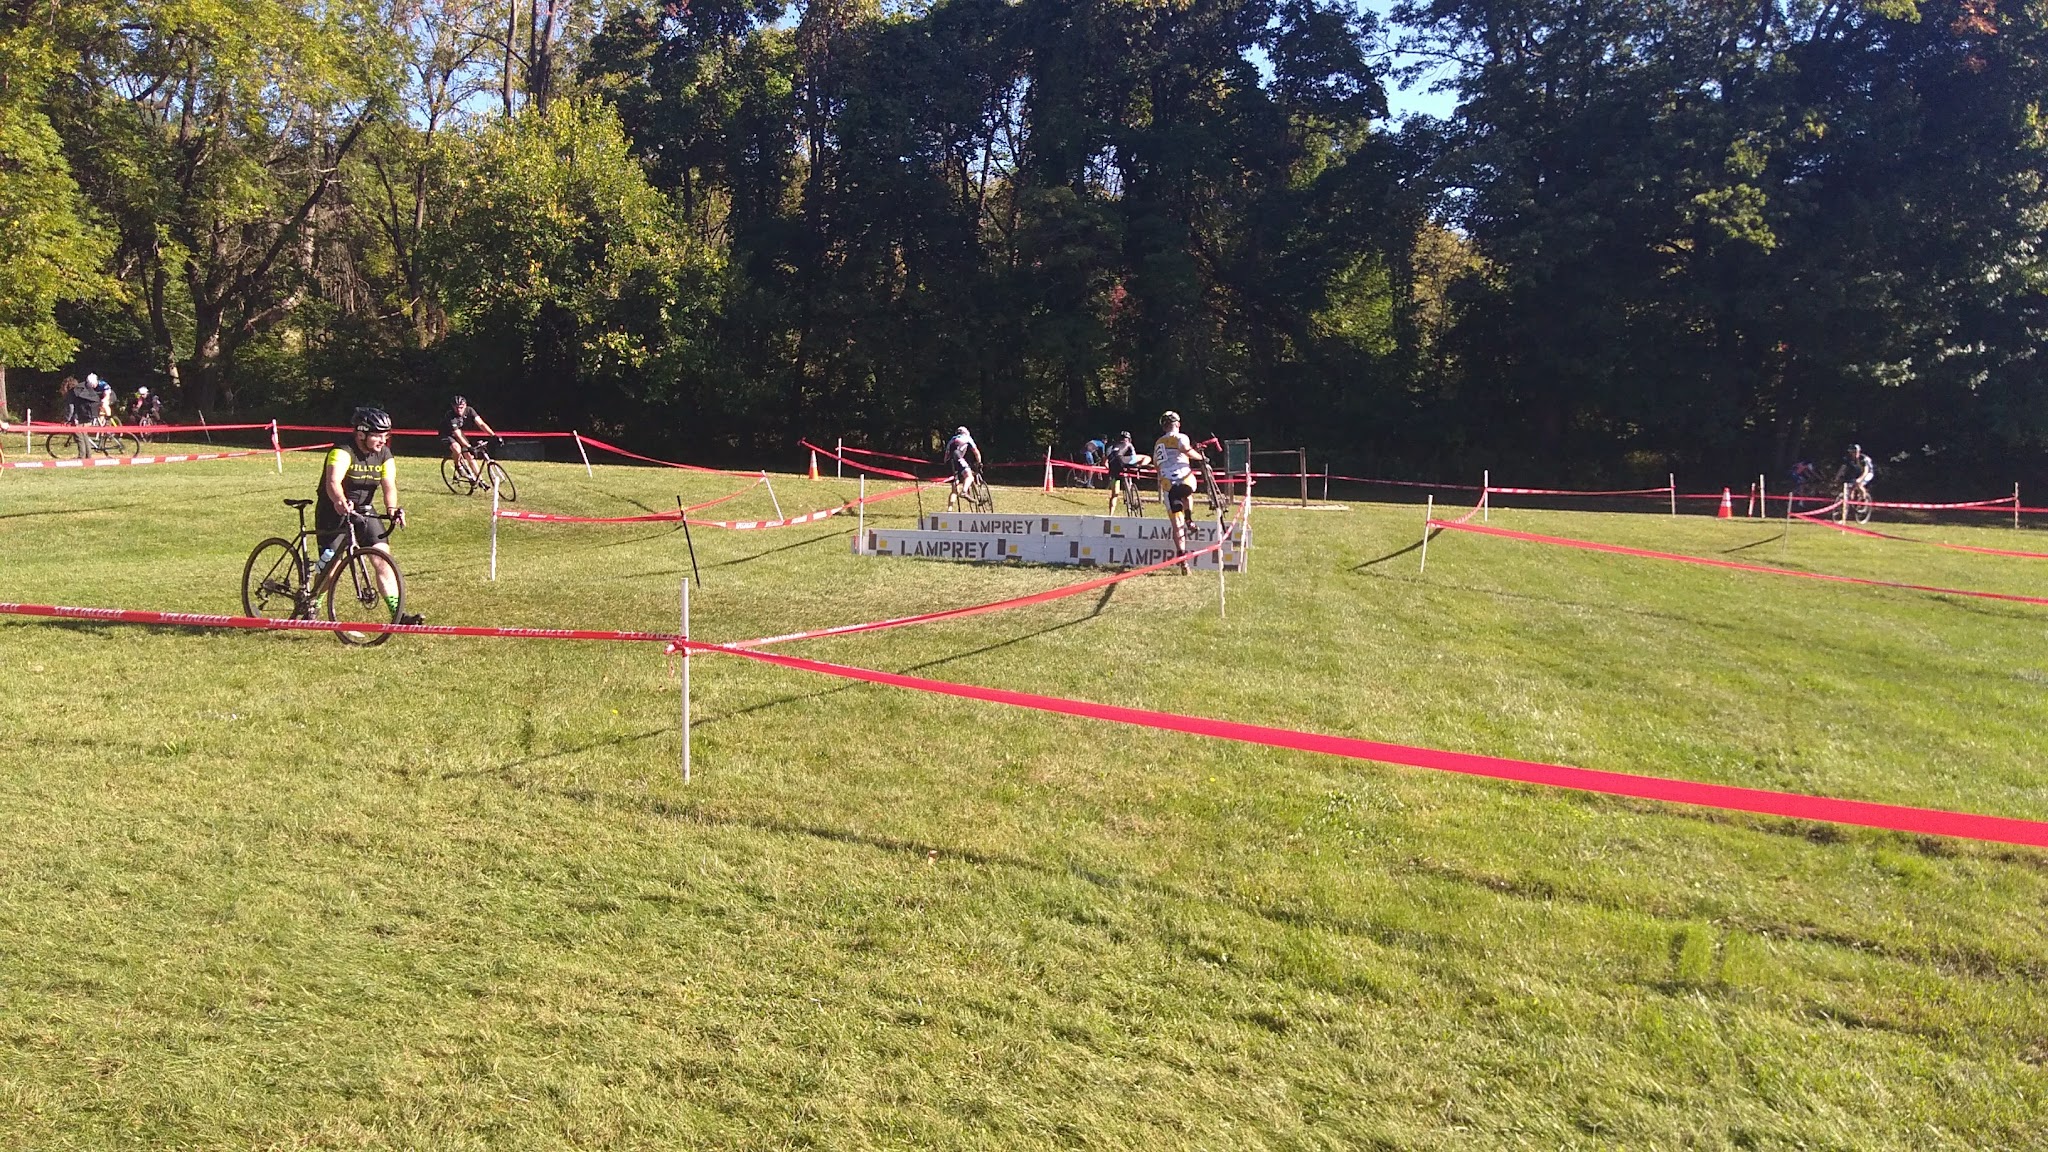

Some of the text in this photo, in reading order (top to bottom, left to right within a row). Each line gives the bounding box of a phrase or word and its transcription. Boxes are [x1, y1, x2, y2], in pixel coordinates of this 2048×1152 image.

[350, 464, 383, 472] ILLTO
[959, 520, 1034, 534] LAMPREY
[1138, 525, 1217, 542] LAMREY
[901, 540, 990, 558] LAMPREY
[1109, 547, 1200, 567] LAMPRY
